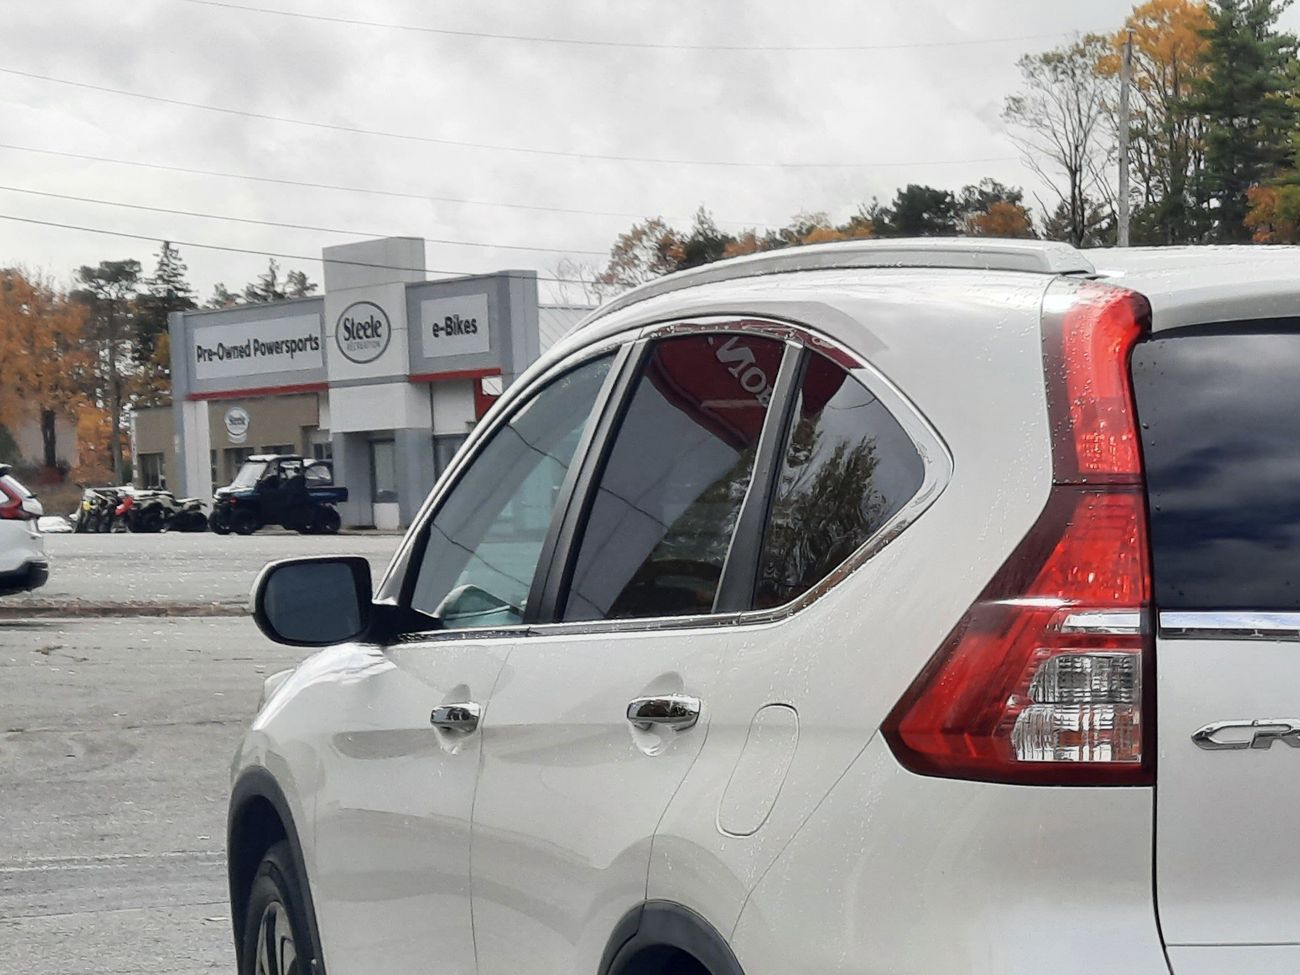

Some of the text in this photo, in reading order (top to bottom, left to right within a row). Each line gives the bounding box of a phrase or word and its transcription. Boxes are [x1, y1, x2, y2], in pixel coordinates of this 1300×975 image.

[342, 315, 382, 341] Steele
[432, 314, 478, 338] e-Bikes
[196, 333, 320, 362] Pre-Owned Powersports
